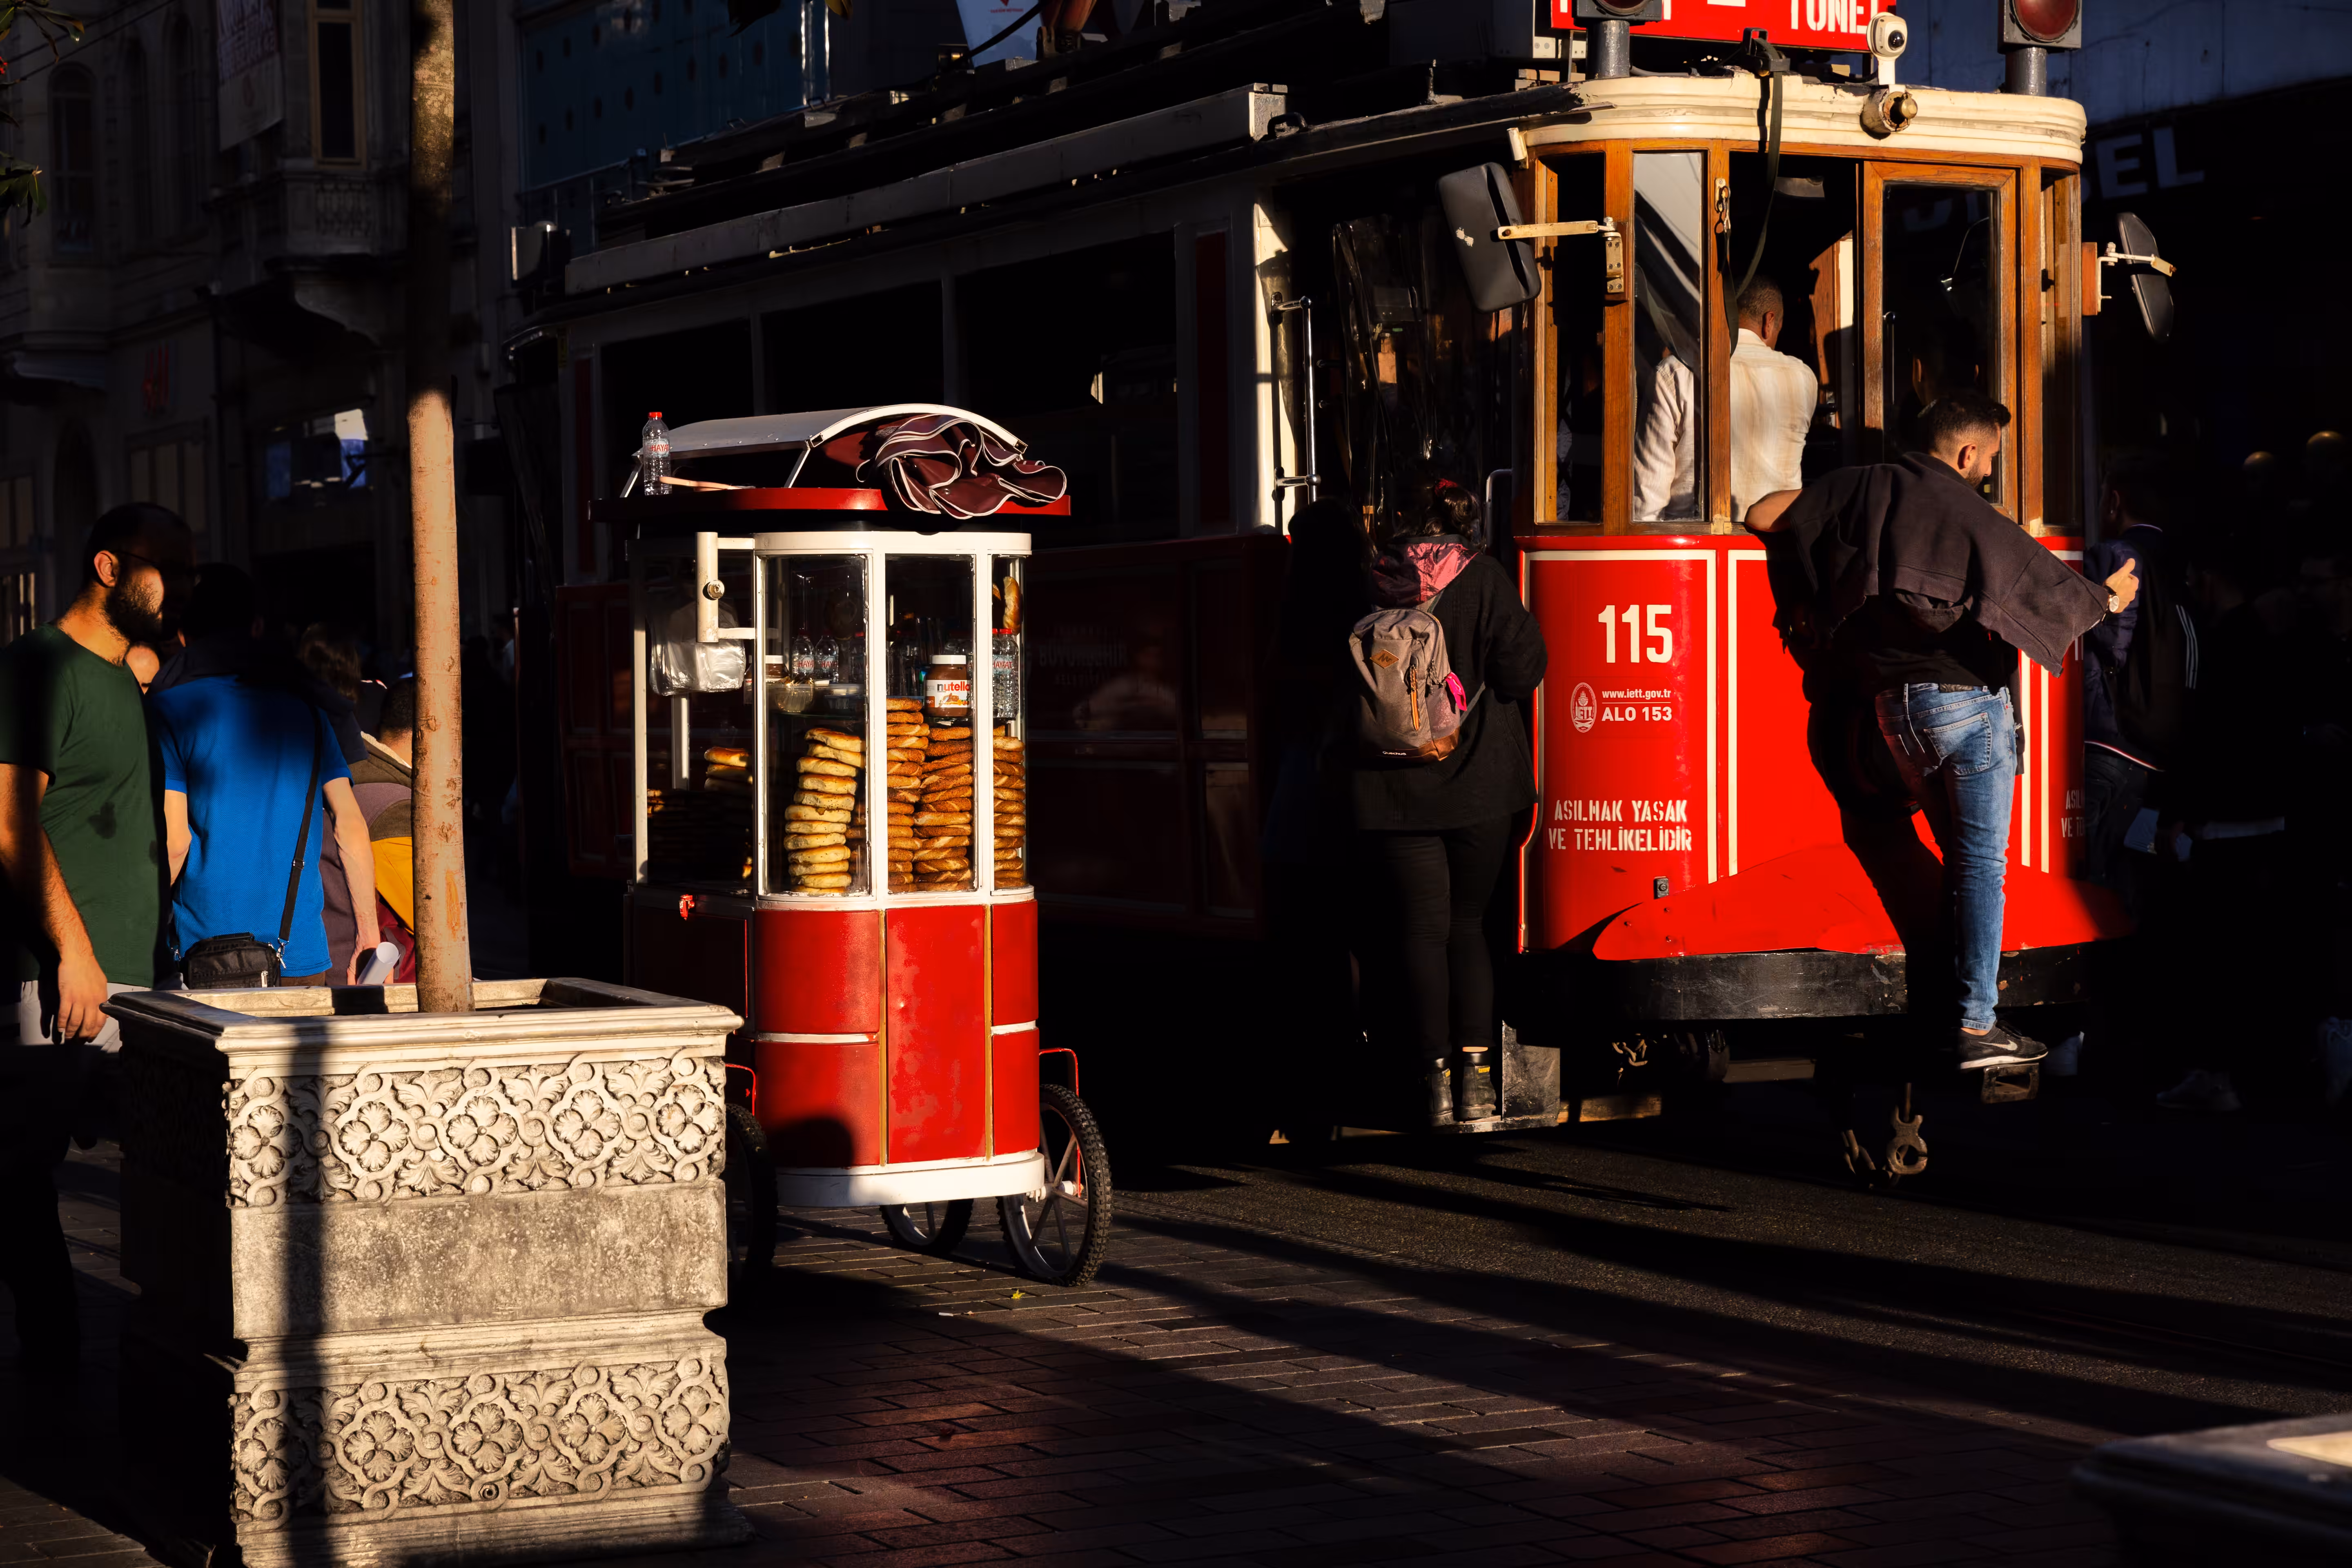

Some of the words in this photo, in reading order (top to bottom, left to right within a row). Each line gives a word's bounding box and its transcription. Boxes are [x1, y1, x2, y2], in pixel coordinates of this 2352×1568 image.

[2082, 126, 2205, 204] EL
[1598, 604, 1673, 663] 115
[937, 681, 971, 691] nutella
[1602, 689, 1671, 700] www.iett.gov.tr
[1601, 707, 1636, 722] ALO
[1642, 706, 1673, 722] 153
[1632, 800, 1687, 822] YASAK
[1548, 828, 1566, 850] VE
[1574, 826, 1692, 851] TEHLİKELİDİR
